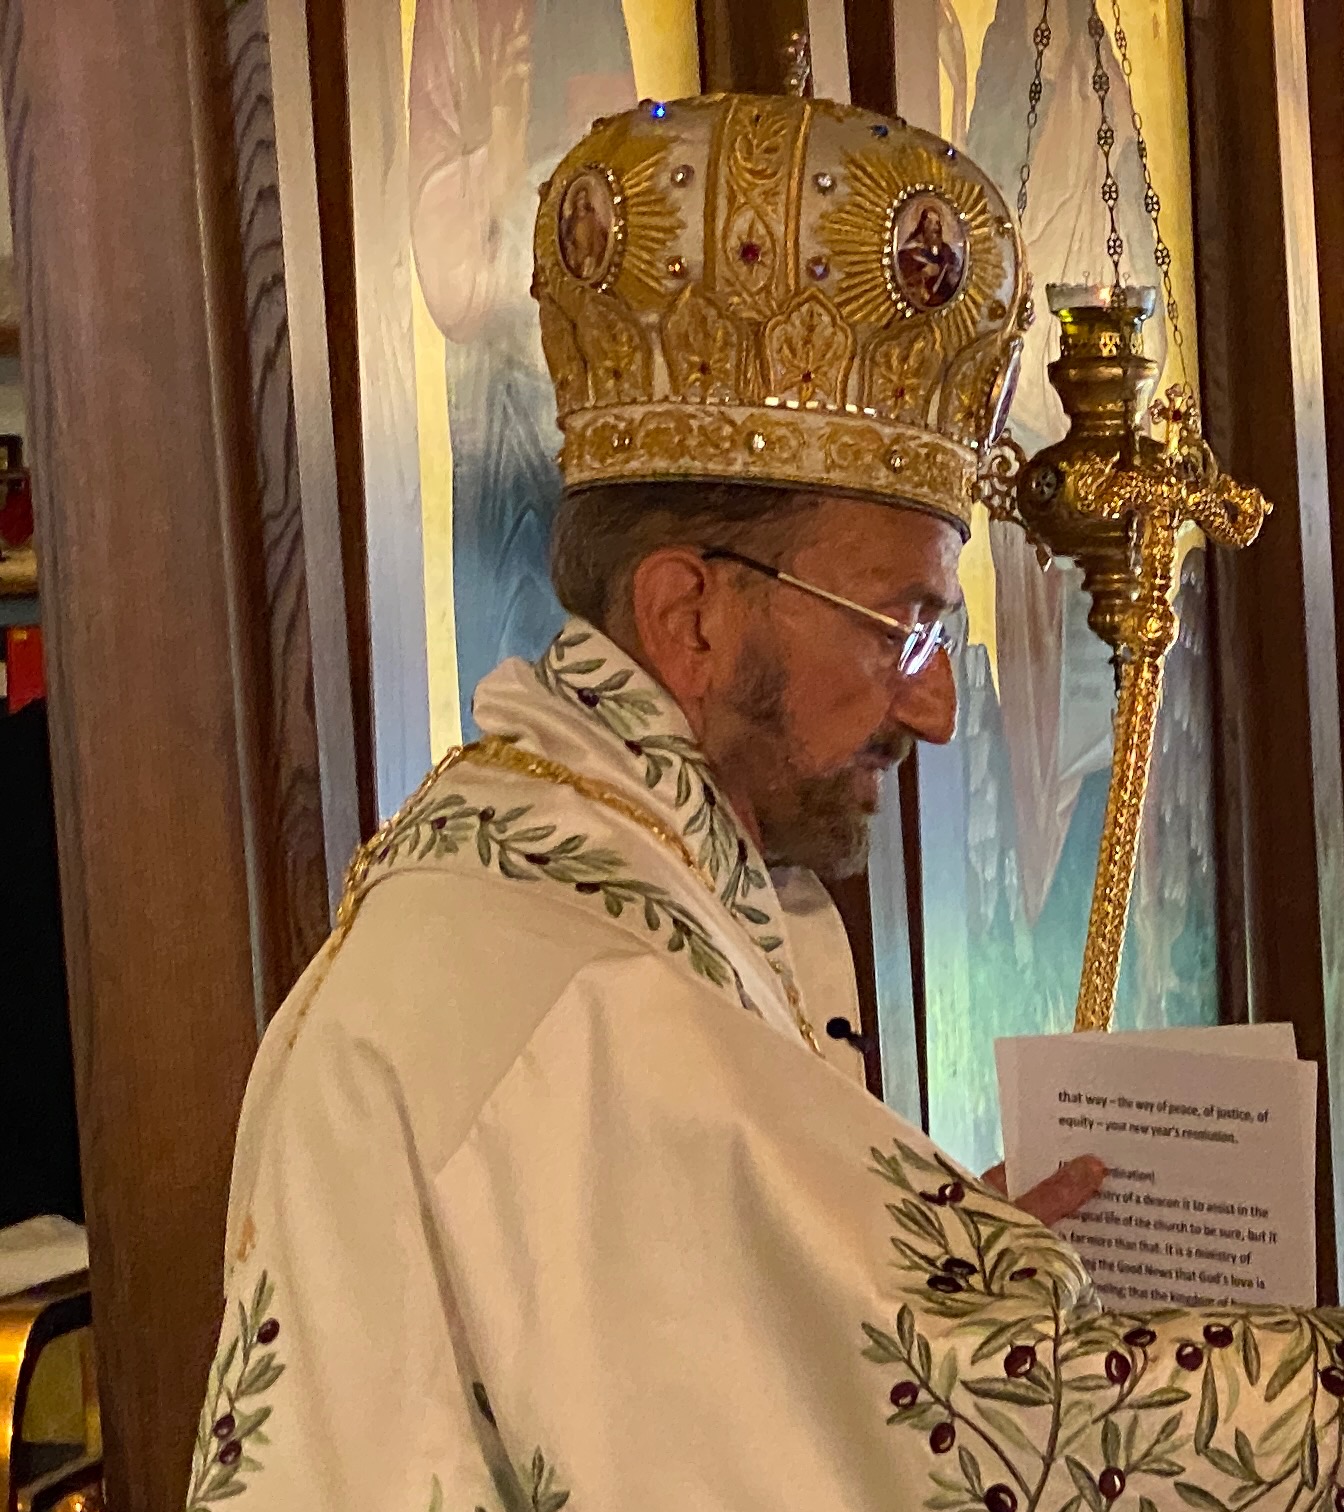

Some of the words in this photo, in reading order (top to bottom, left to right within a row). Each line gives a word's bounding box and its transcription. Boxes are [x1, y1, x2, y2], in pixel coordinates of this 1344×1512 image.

[1058, 1089, 1083, 1104] that
[1085, 1094, 1108, 1109] way
[1156, 1099, 1168, 1114] of
[1203, 1104, 1215, 1118] of
[1257, 1108, 1270, 1123] of
[1058, 1115, 1094, 1132] equity
[1250, 1206, 1269, 1219] the
